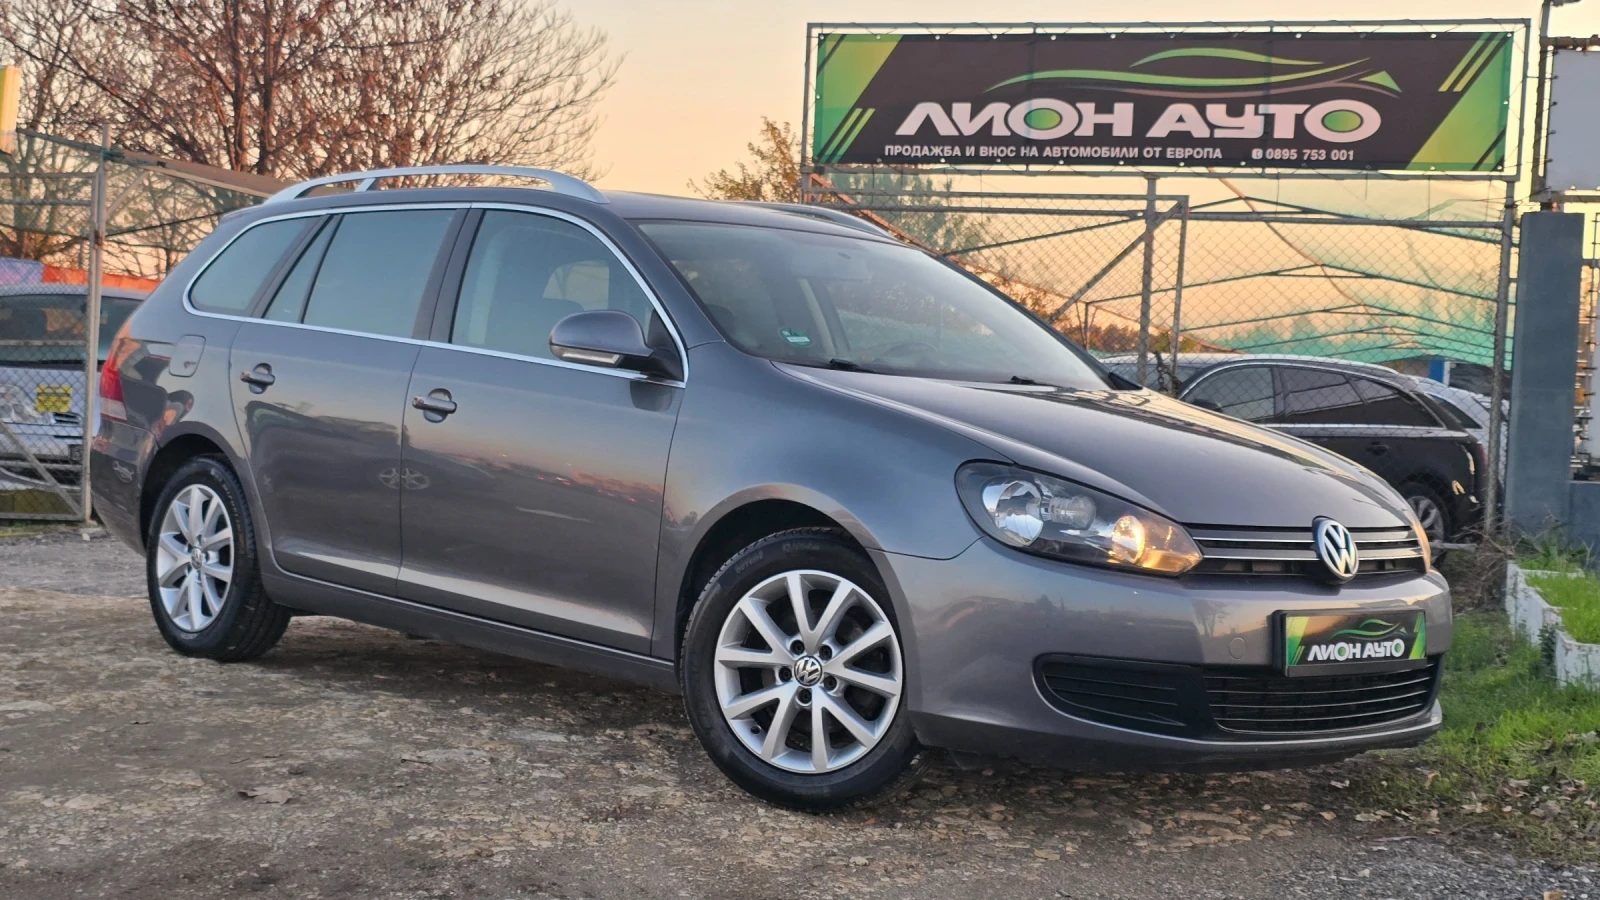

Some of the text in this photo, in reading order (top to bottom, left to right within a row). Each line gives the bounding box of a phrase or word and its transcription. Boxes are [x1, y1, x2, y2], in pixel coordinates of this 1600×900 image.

[895, 98, 1382, 143] ЛИОН АУТО
[884, 145, 1223, 159] ПРОДАЖБА И ВНОС НА АВТОМОБИЛИ ОТ ЕВРОПА
[1265, 148, 1355, 161] 0895 753 001
[1307, 638, 1405, 662] ЛИОН АУТО
